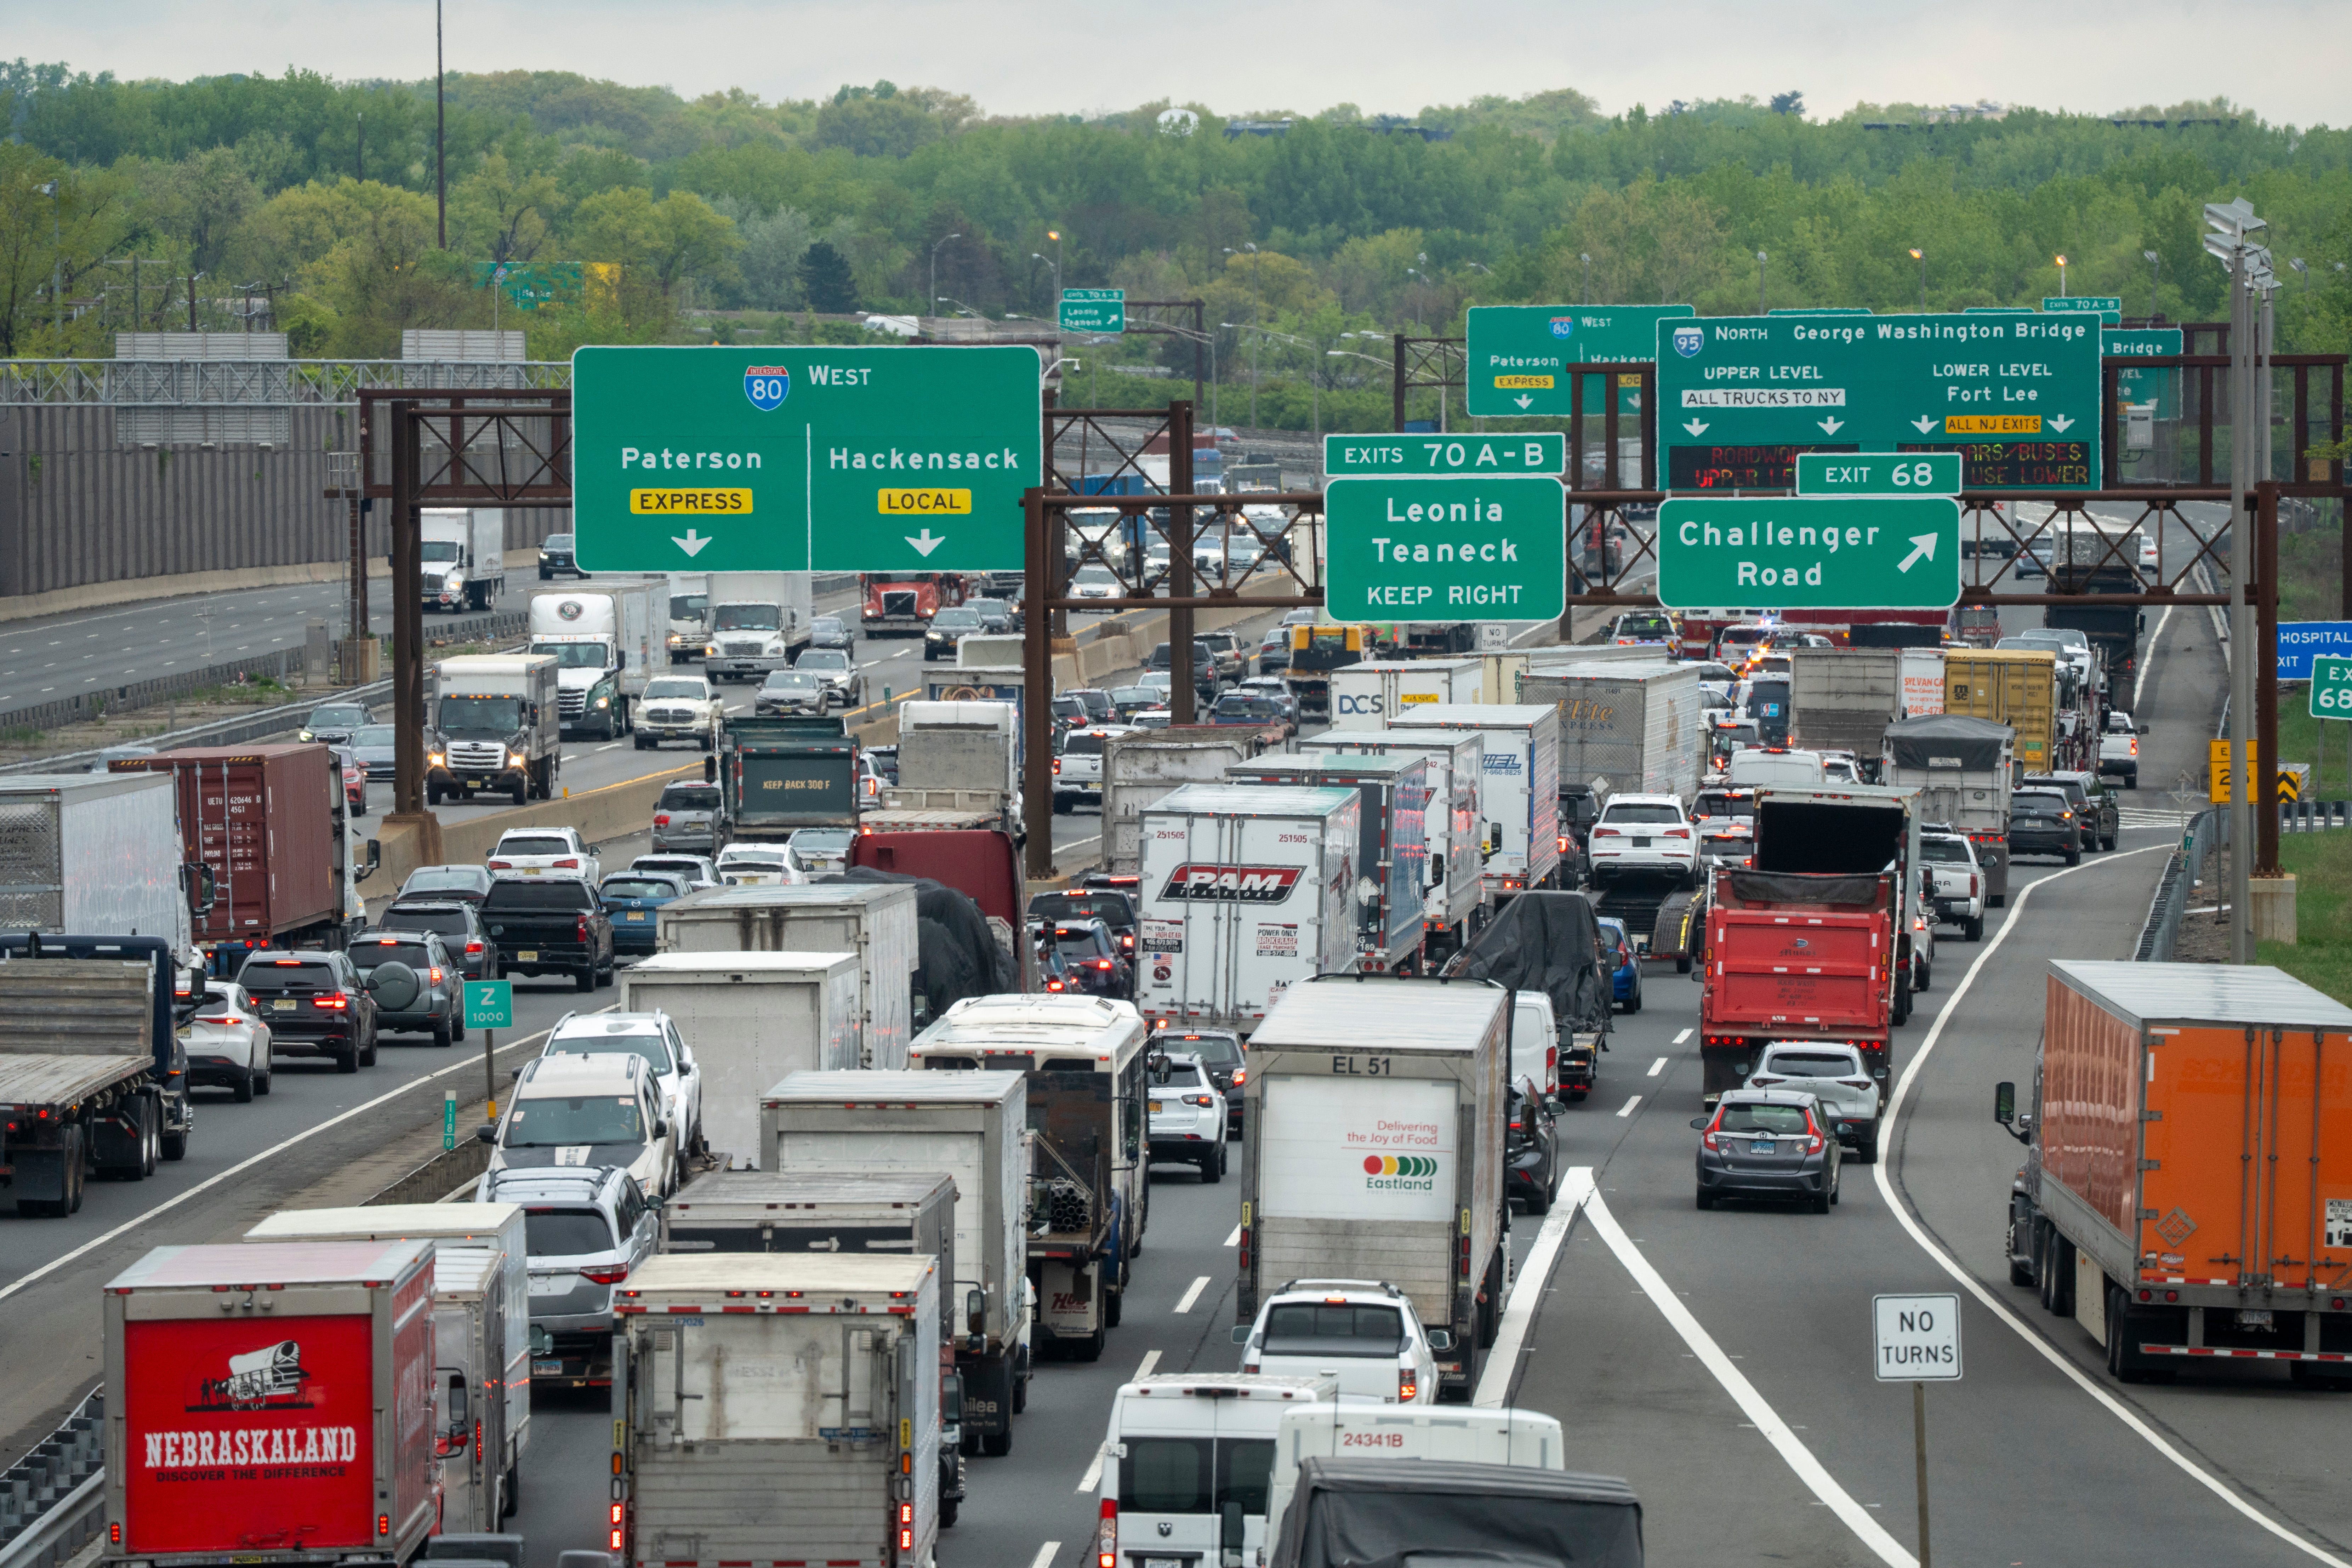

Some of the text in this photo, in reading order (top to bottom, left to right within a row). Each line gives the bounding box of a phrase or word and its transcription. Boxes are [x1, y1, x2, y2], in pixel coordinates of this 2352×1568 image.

[2076, 300, 2089, 309] 70
[2092, 300, 2115, 309] A-B
[1553, 323, 1569, 335] 80
[1582, 317, 1612, 327] WEST
[1677, 323, 2086, 350] 95 NORTH George Washington Bridge
[2113, 342, 2163, 355] Bridge
[1490, 355, 1559, 367] Paterson
[1704, 366, 1823, 380] UPPER LEVEL
[1933, 364, 2052, 377] LOWER LEVEL
[752, 365, 871, 400] 80 WEST
[1499, 377, 1549, 386] EXPRESS
[1687, 391, 1841, 405] ALL TRUCKS TO NY
[1947, 386, 2038, 401] Fort Lee
[1948, 418, 2040, 431] ALL NJ EXITS
[622, 447, 1019, 470] Paterson Hackensack
[1345, 448, 1403, 464] EXITS
[1424, 444, 1465, 467] 70
[1696, 468, 1758, 488] UPPER
[1826, 463, 1933, 486] EXIT 68
[1971, 465, 2088, 484] USE LOWER
[640, 494, 961, 511] EXPRESS LOCAL
[1387, 498, 1503, 523] Leonia
[1679, 521, 1880, 553] Challenger
[1372, 538, 1518, 563] Teaneck
[1737, 562, 1822, 587] Road
[1368, 586, 1522, 605] KEEP RIGHT
[1904, 677, 1932, 686] SYLVAN
[1339, 694, 1383, 714] DCS
[2319, 688, 2352, 709] 68
[1557, 697, 1614, 721] Elite
[763, 780, 783, 789] KEEP
[1157, 831, 1308, 844] 251505 251505
[1183, 871, 1284, 891] PAM
[480, 988, 495, 1006] Z
[473, 1012, 504, 1022] 1000
[1333, 1056, 1391, 1075] EL 51
[1377, 1121, 1438, 1134] Delivering
[1348, 1132, 1438, 1145] the Joy of Food
[1366, 1177, 1433, 1191] Eastland
[1900, 1311, 1934, 1332] NO
[1882, 1345, 1954, 1364] TURNS
[144, 1426, 357, 1469] NEBRASKALAND
[1343, 1433, 1404, 1448] 24341B
[156, 1465, 346, 1483] DISCOVER THE DIFFERENCE
